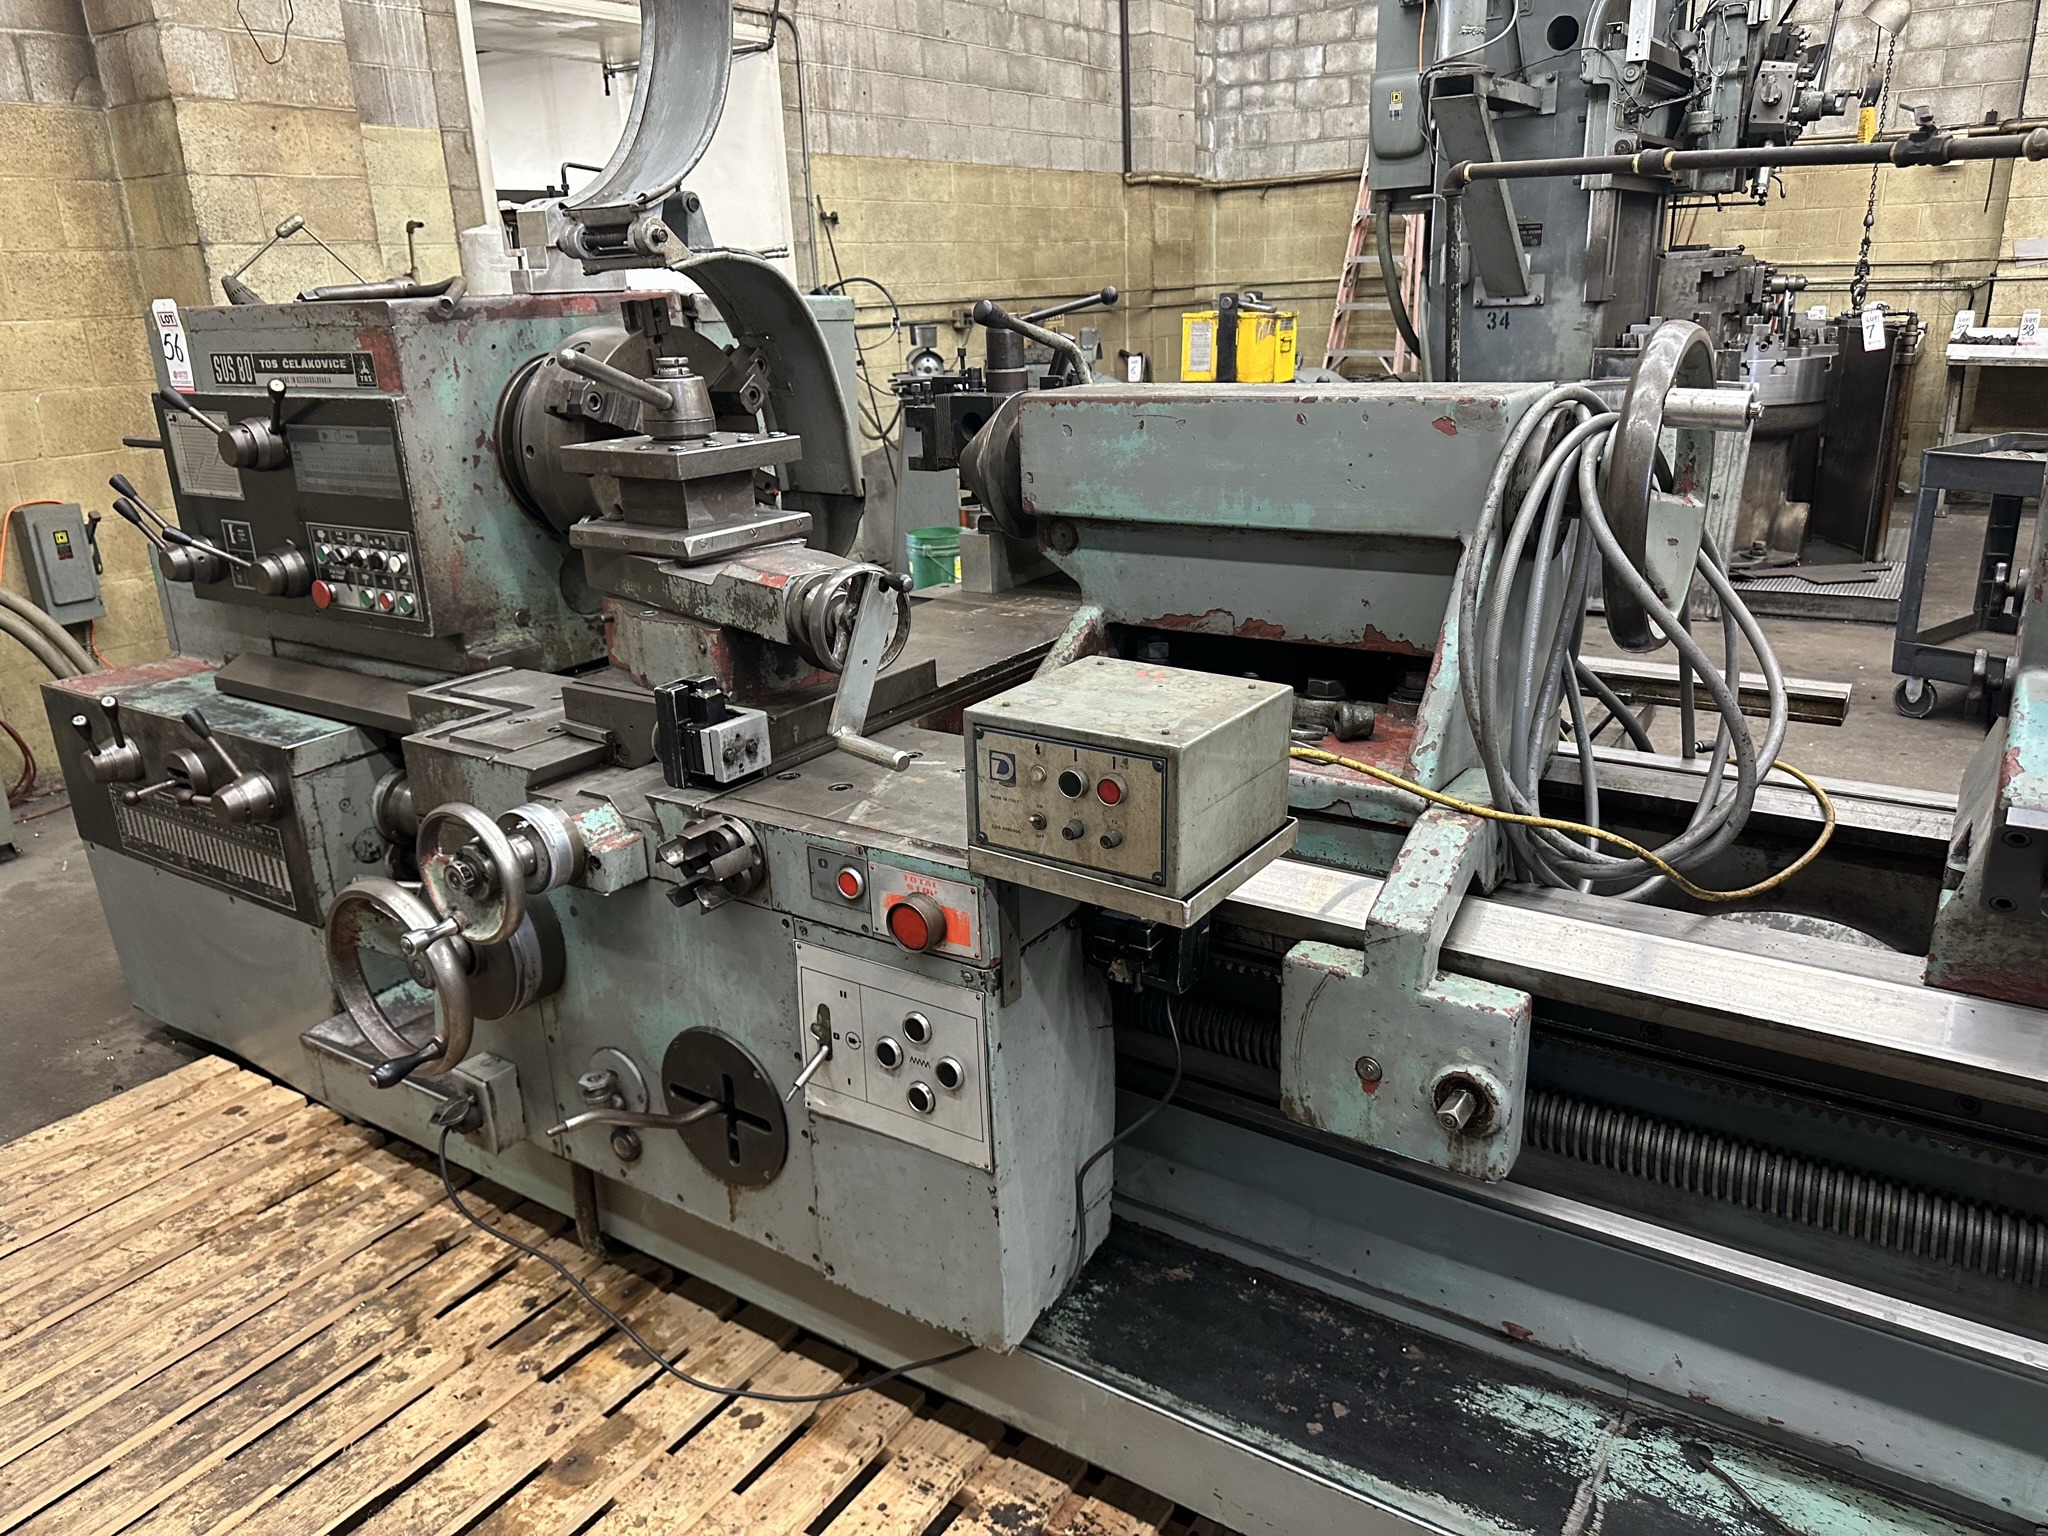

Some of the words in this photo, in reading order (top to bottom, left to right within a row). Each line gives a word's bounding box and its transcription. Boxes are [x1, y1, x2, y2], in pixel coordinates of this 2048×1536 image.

[160, 314, 175, 324] LOT
[1486, 311, 1510, 330] 34
[1866, 324, 1876, 339] 7
[1953, 324, 1970, 335] 37
[2021, 324, 2035, 337] 38
[163, 333, 184, 363] 56
[213, 355, 237, 382] SUS
[237, 355, 253, 383] 80
[259, 359, 279, 369] TOS
[1130, 365, 1137, 375] 6
[903, 873, 937, 888] TOTAL
[906, 882, 938, 896] STOP
